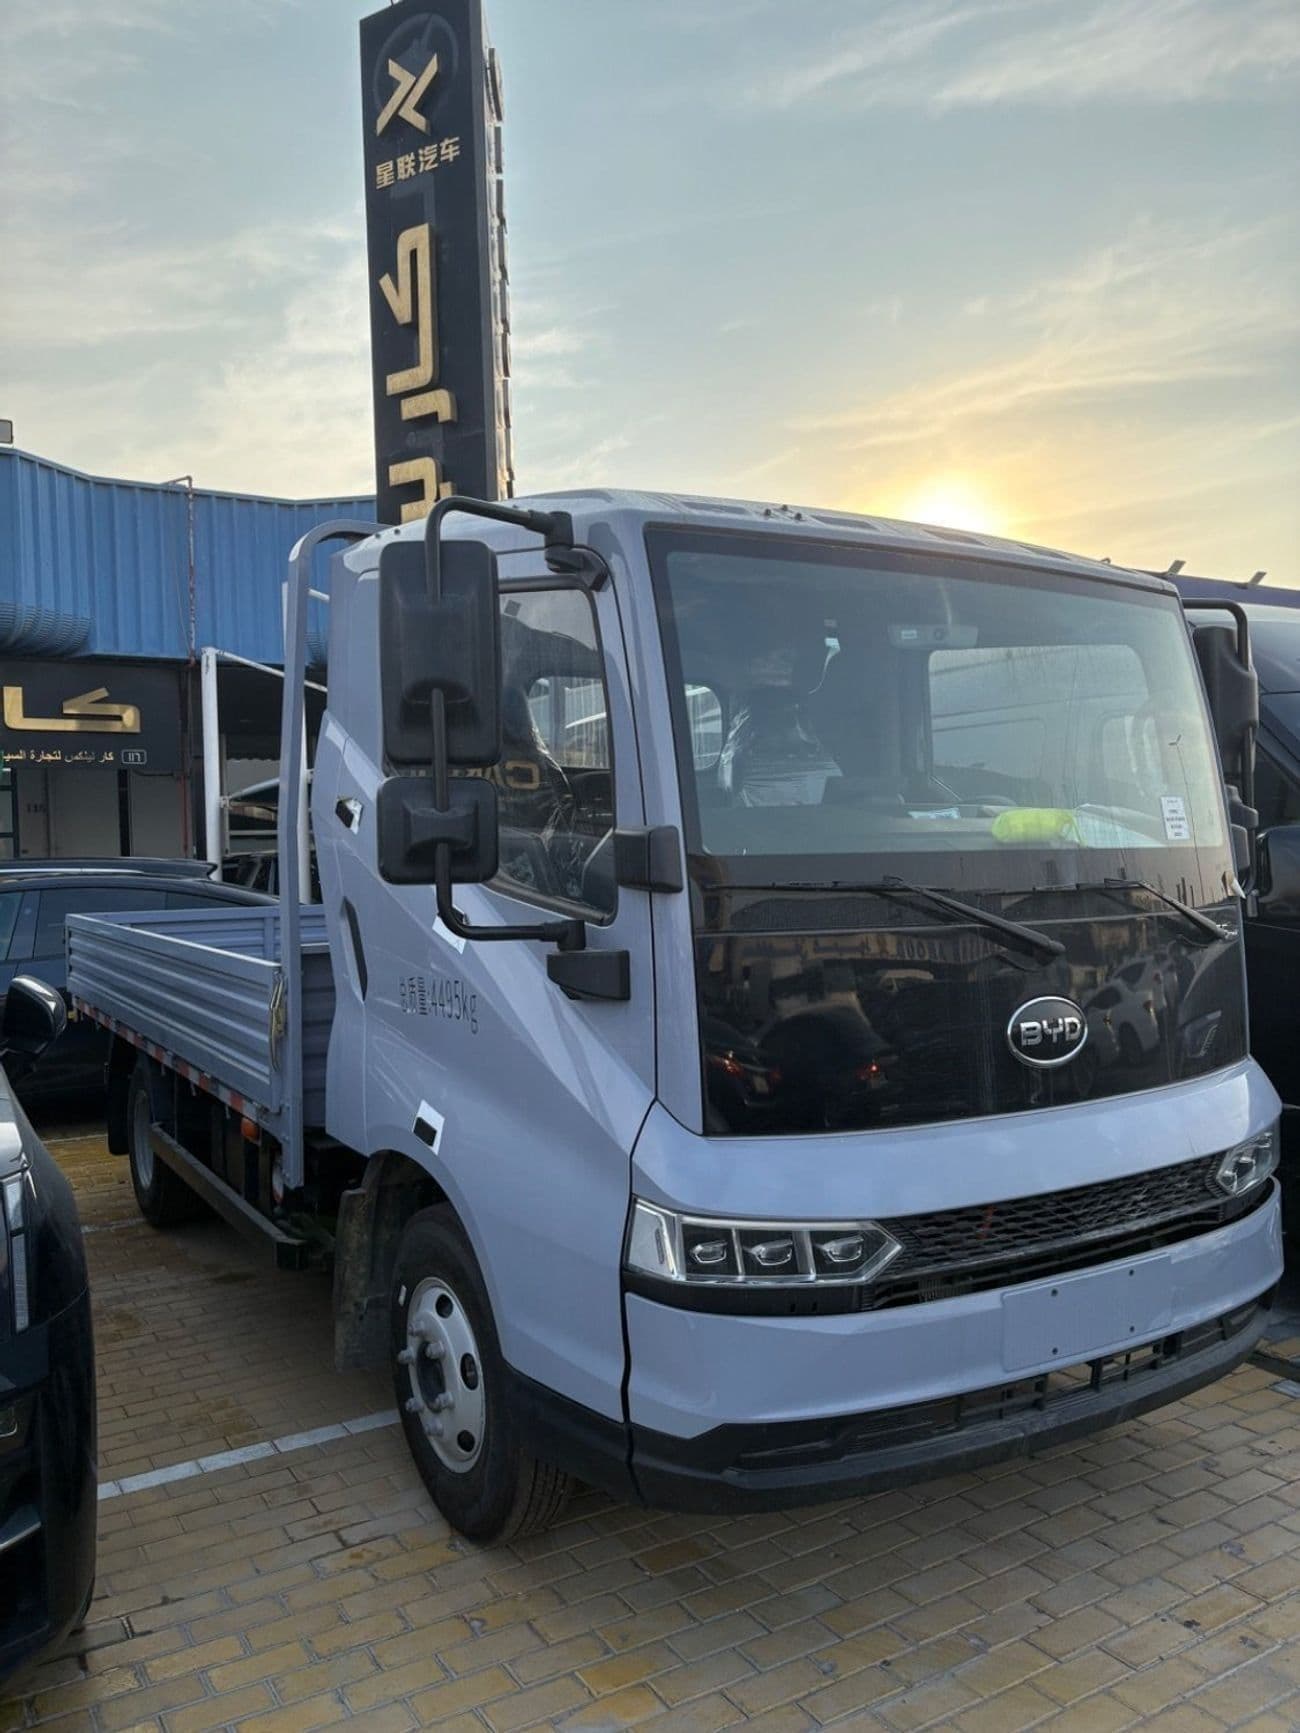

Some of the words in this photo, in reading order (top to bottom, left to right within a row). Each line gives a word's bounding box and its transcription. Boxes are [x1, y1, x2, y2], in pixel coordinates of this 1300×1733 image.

[376, 136, 461, 189] 星联汽车
[3, 750, 26, 762] السي
[30, 750, 62, 763] لتجارة
[98, 751, 114, 763] كار
[1020, 1016, 1081, 1046] BYD
